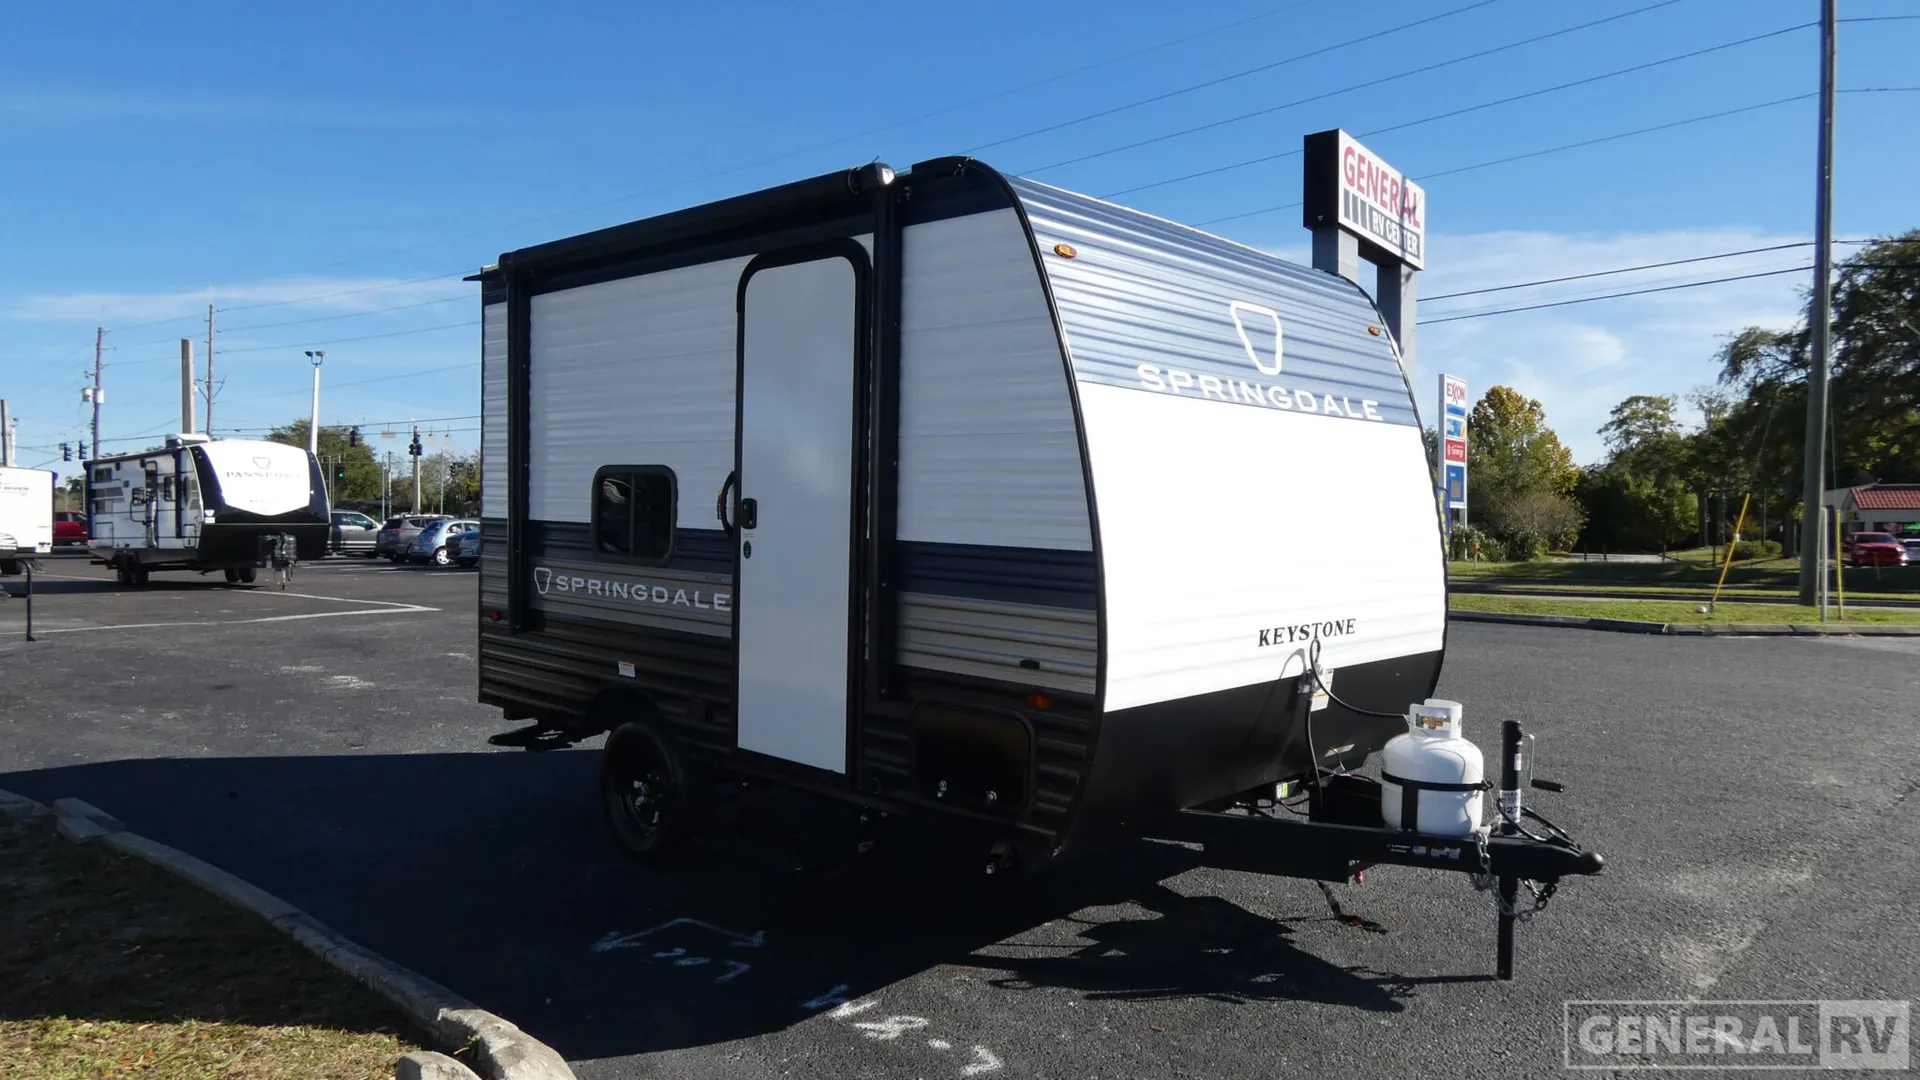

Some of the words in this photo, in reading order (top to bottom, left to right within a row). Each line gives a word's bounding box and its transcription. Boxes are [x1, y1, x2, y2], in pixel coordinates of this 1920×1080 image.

[1343, 146, 1420, 228] GENERAL
[1372, 211, 1385, 236] RV
[1136, 364, 1384, 421] SPRINGDALE
[556, 575, 731, 612] SPRINGDALE
[1258, 618, 1356, 647] KEYSTONE
